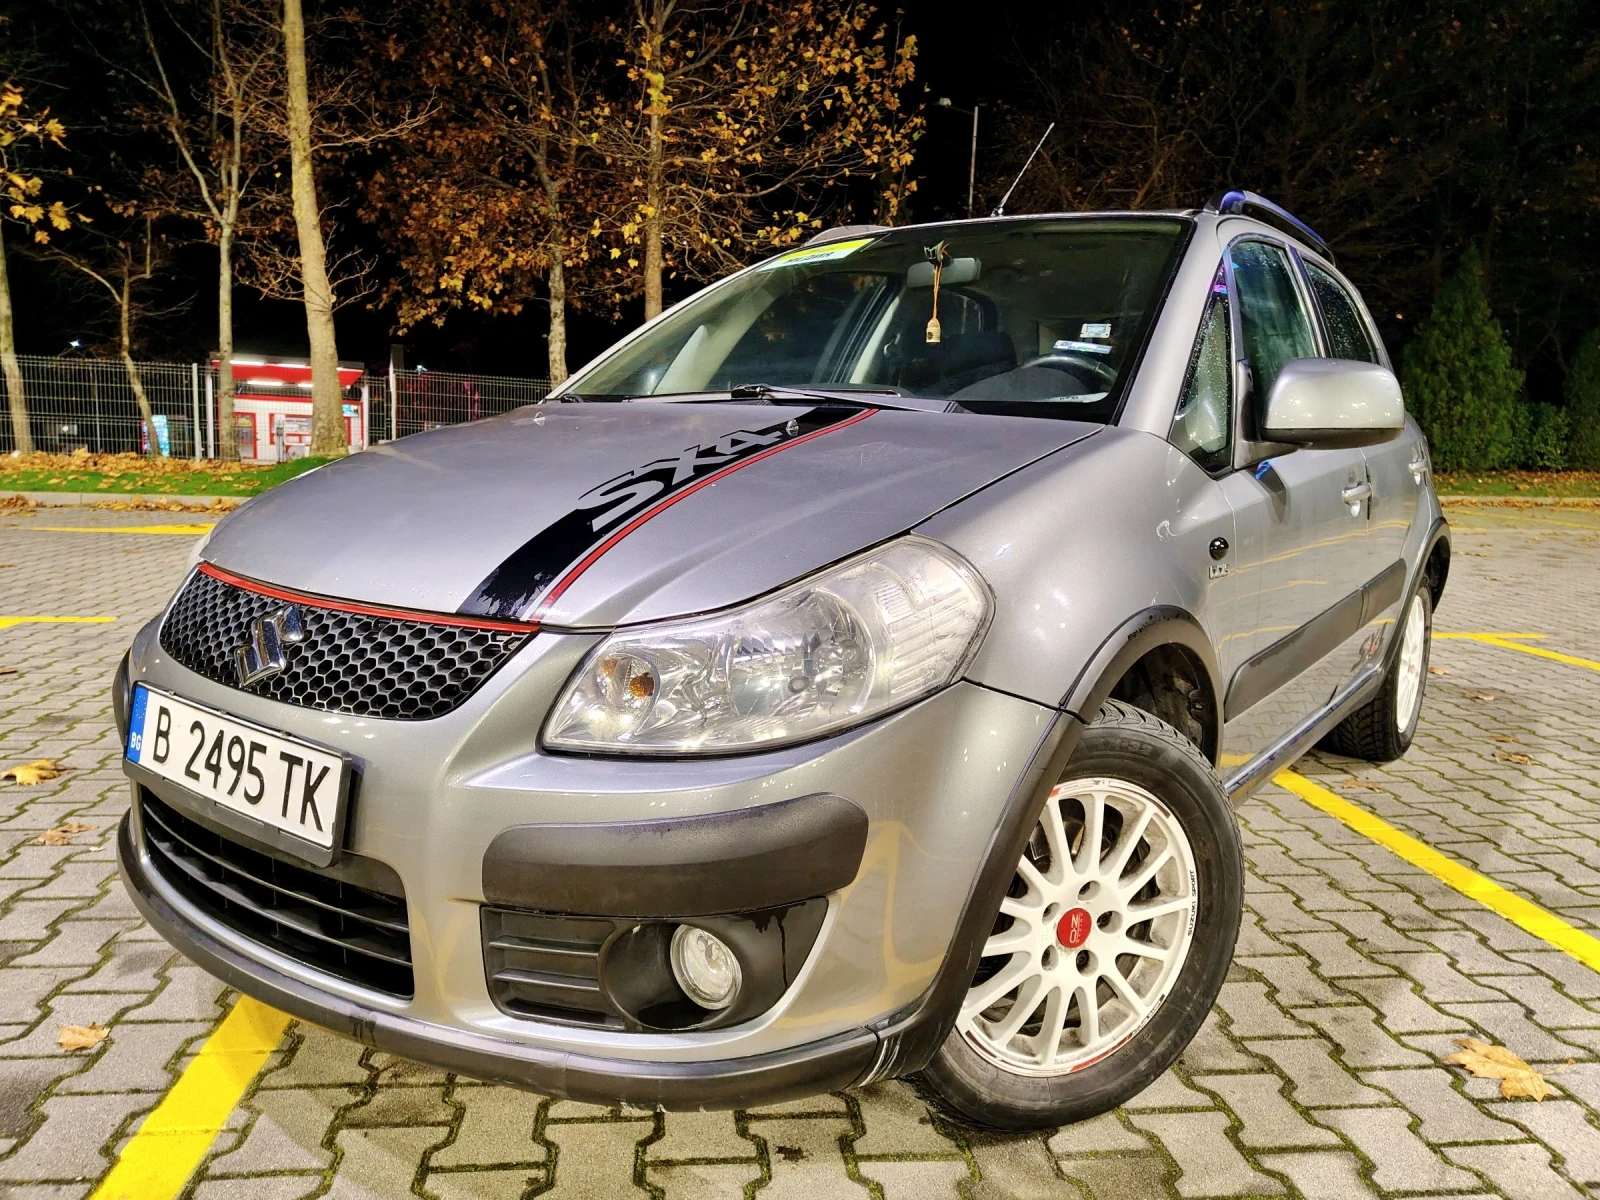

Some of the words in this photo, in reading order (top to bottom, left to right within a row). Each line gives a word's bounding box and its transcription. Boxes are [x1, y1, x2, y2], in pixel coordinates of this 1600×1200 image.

[130, 731, 142, 751] BG
[153, 706, 171, 764] B
[184, 720, 267, 805] 2495
[279, 751, 331, 832] TK
[1189, 870, 1197, 897] SPORT
[1188, 901, 1197, 936] SUZUKI
